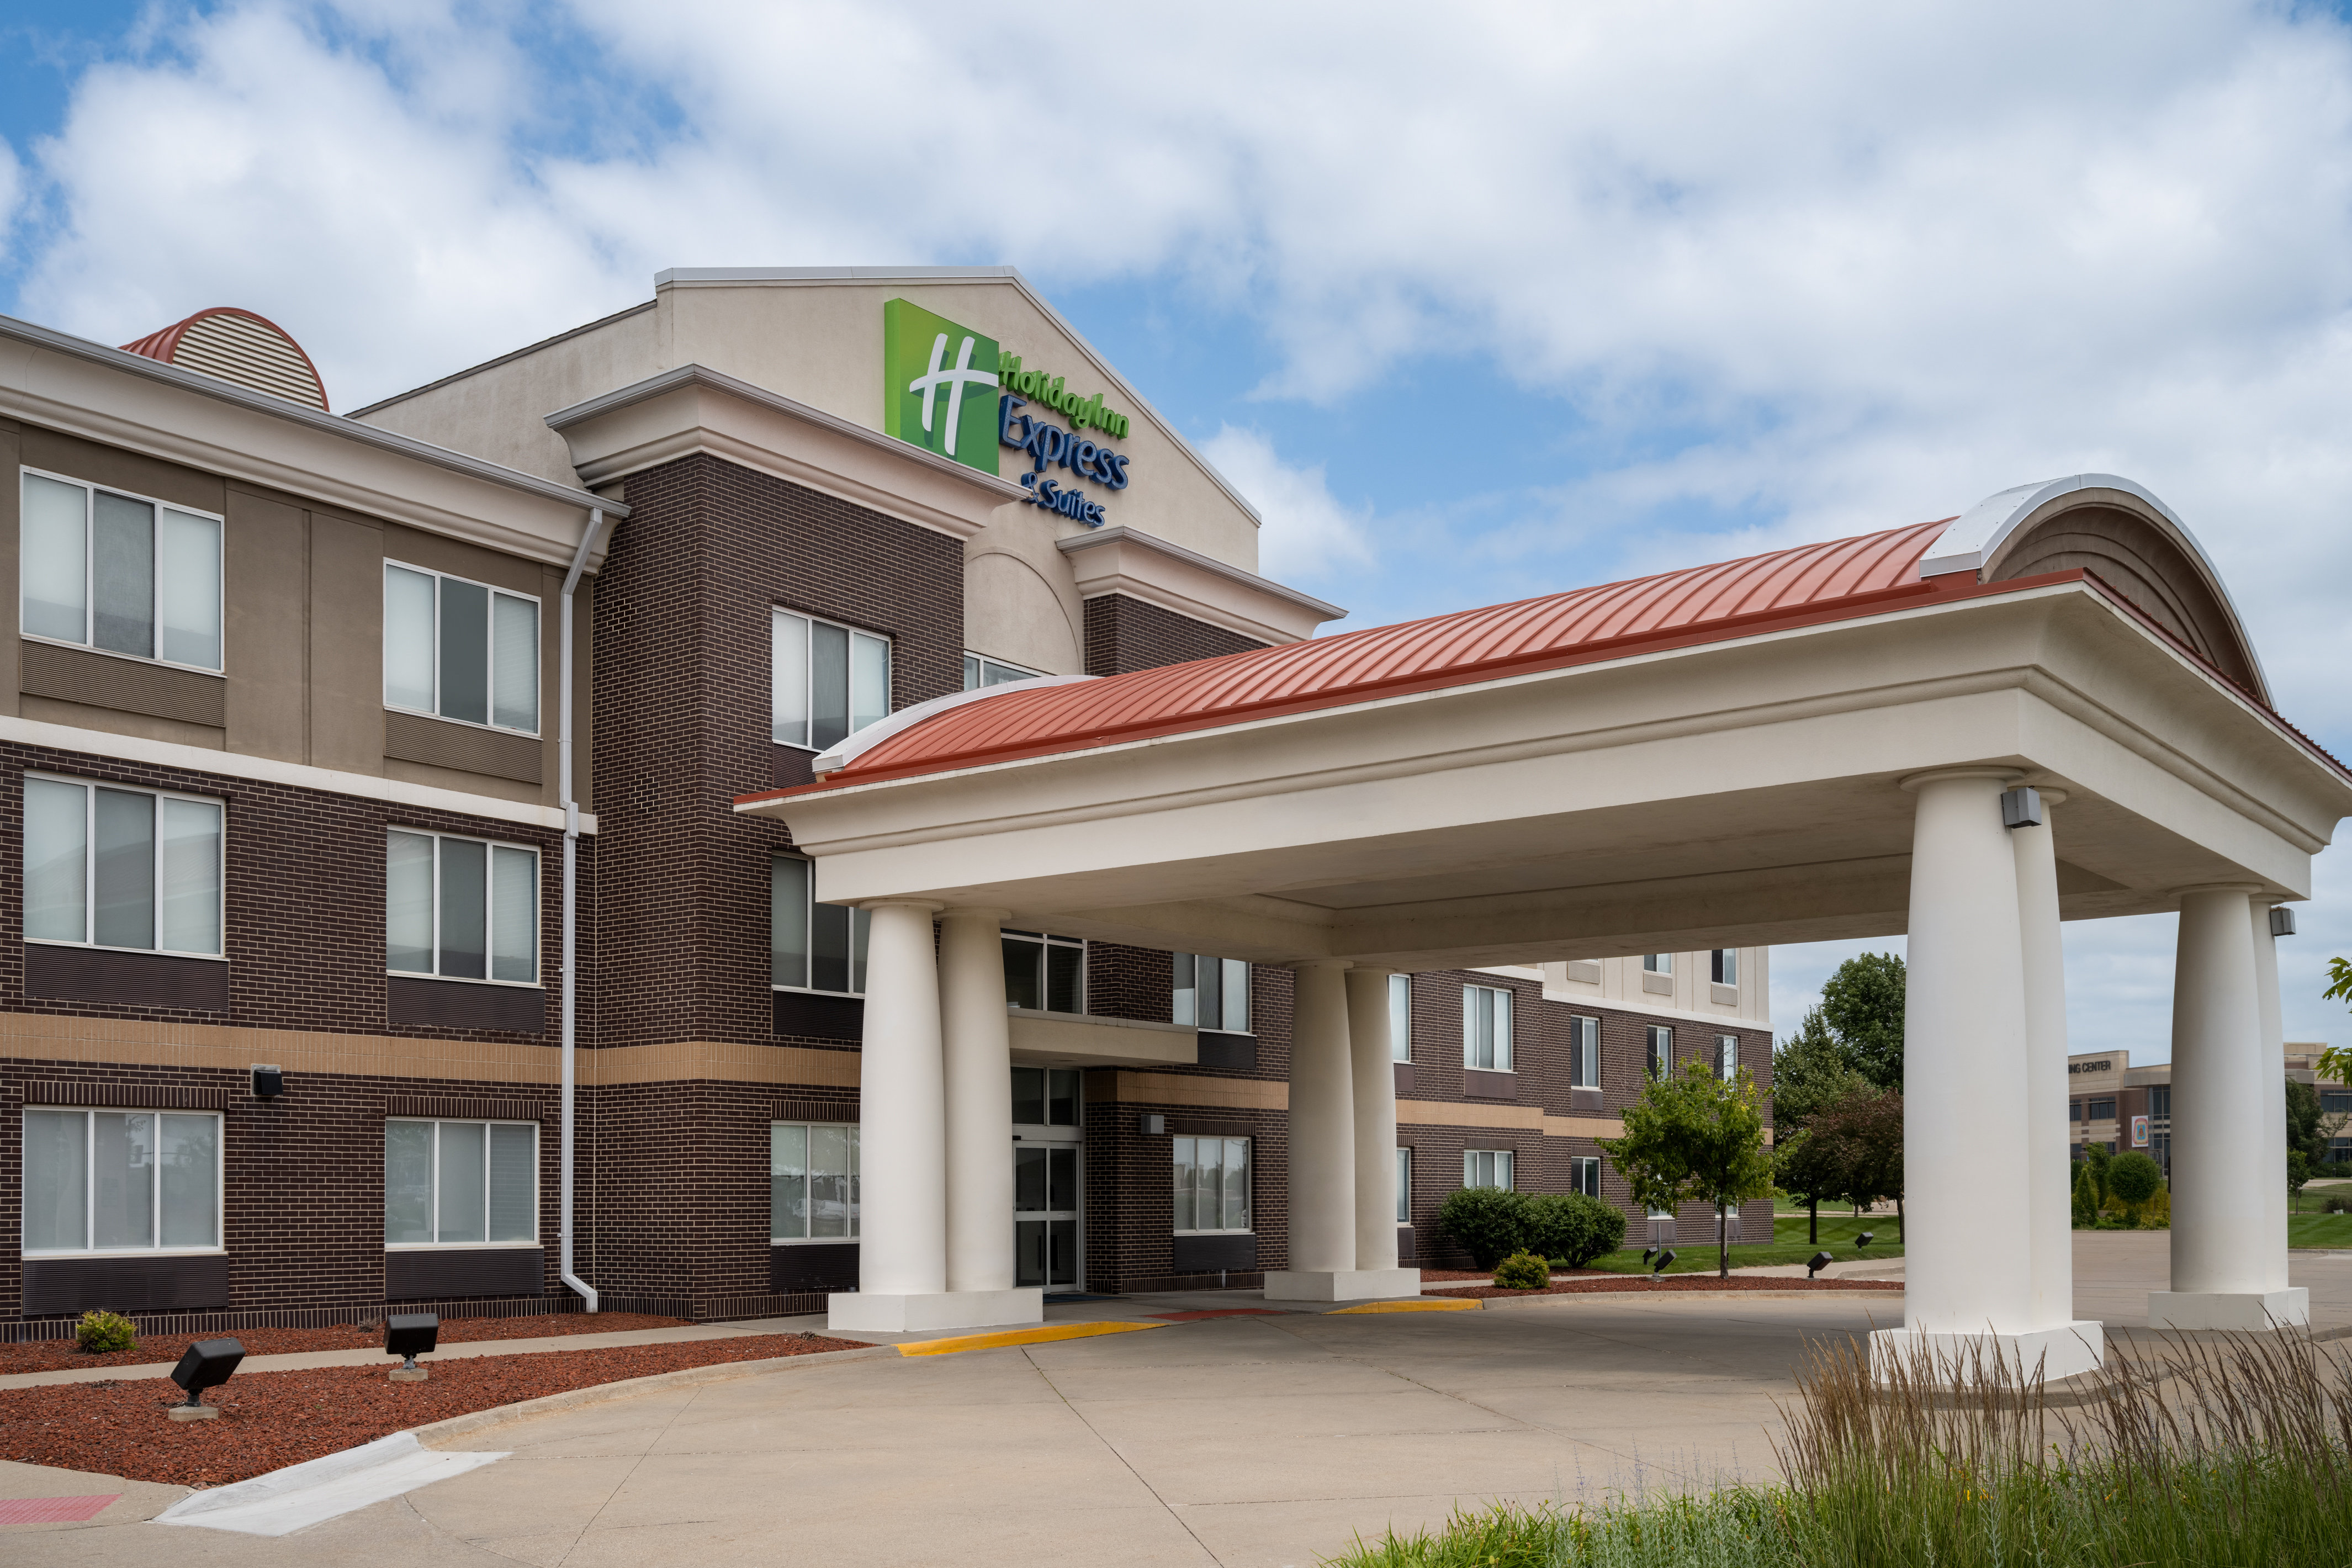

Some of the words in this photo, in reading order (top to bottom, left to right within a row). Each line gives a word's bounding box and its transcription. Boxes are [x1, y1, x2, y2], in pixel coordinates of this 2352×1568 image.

[999, 394, 1130, 490] Express
[1021, 472, 1039, 505] &
[1037, 479, 1106, 528] Suites
[2082, 1060, 2111, 1073] CENTER
